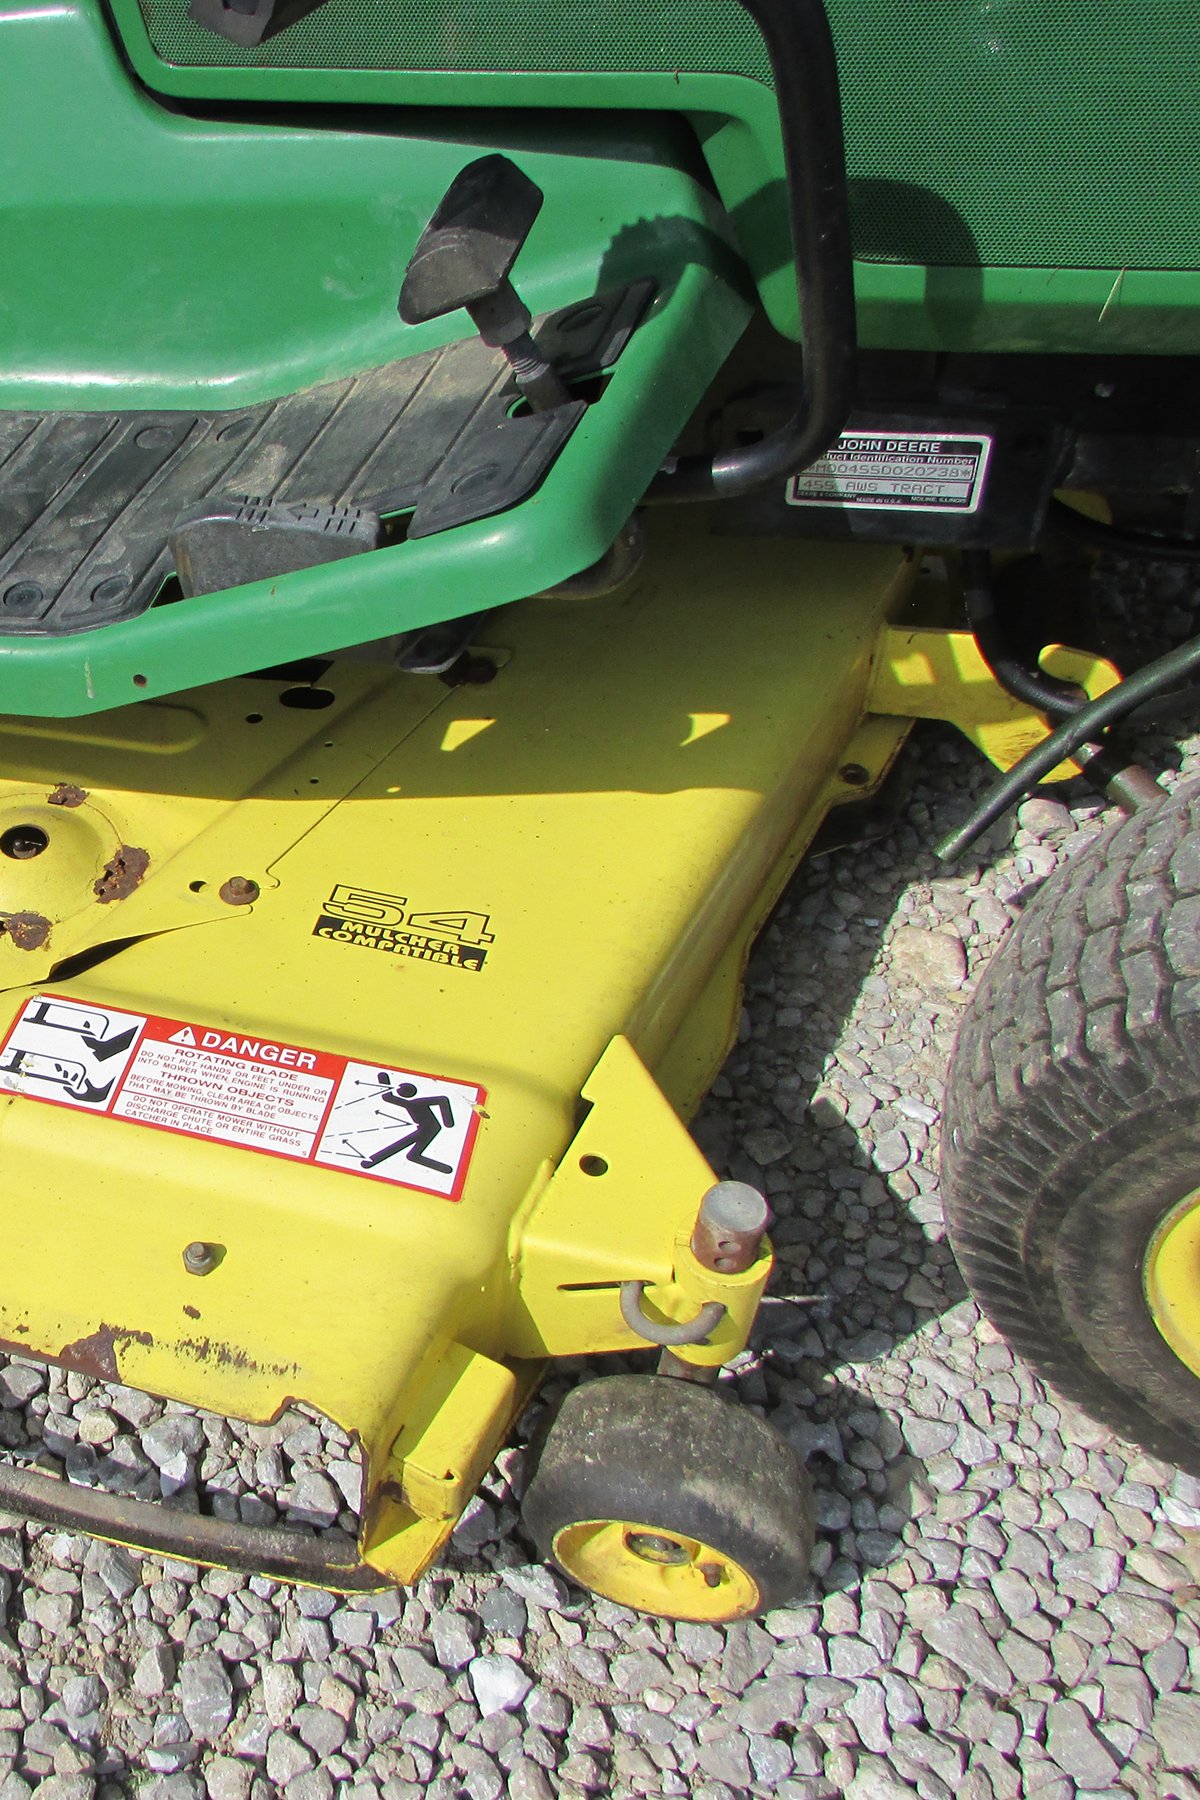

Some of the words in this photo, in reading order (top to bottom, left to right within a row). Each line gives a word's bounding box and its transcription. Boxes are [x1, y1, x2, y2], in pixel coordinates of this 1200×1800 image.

[823, 452, 847, 460] duct
[850, 453, 924, 463] Identification
[927, 456, 975, 465] Number
[838, 440, 881, 451] JOHN
[885, 441, 941, 453] DEERE
[803, 480, 834, 490] 455
[845, 481, 878, 492] AWS
[890, 483, 945, 494] TRACT
[322, 883, 496, 946] 54
[318, 927, 479, 970] COMPATIBLE
[341, 920, 460, 955] MULCHER
[174, 1048, 246, 1070] ROTATING
[250, 1065, 299, 1082] BLADE
[200, 1032, 317, 1070] DANGER
[137, 1056, 159, 1066] INTO
[162, 1062, 198, 1075] MOWER
[201, 1070, 228, 1082] WHEN
[231, 1078, 266, 1090] ENGINE
[282, 1088, 325, 1104] RUNNING
[140, 1050, 154, 1058] DO
[157, 1053, 177, 1062] NOT
[179, 1058, 197, 1067] PUT
[200, 1063, 231, 1075] HANDS
[235, 1071, 249, 1079] OR
[251, 1074, 274, 1085] FEET
[278, 1081, 311, 1092] UNDER
[314, 1088, 328, 1097] OR
[160, 1071, 223, 1090] THROWN
[227, 1086, 295, 1107] OBJECTS
[128, 1080, 150, 1090] THAT
[152, 1086, 172, 1095] MAY
[190, 1094, 228, 1108] THROWN
[230, 1103, 244, 1111] BY
[245, 1107, 277, 1119] BLADE
[130, 1073, 164, 1086] BEFORE
[166, 1081, 204, 1097] MOWING,
[206, 1091, 236, 1102] CLEAR
[237, 1098, 261, 1108] AREA
[263, 1103, 277, 1111] OF
[277, 1107, 319, 1121] OBJECTS
[124, 1108, 168, 1124] CATCHER
[182, 1122, 213, 1134] PLACE
[126, 1101, 179, 1118] DISCHARGE
[181, 1113, 213, 1126] CHUTE
[215, 1121, 230, 1130] OR
[231, 1125, 266, 1138] ENTIRE
[268, 1134, 301, 1147] GRASS
[133, 1095, 147, 1103] DO
[149, 1099, 168, 1107] NOT
[171, 1103, 215, 1119] OPERATE
[217, 1114, 253, 1128] MOWER
[256, 1122, 300, 1138] WITHOUT
